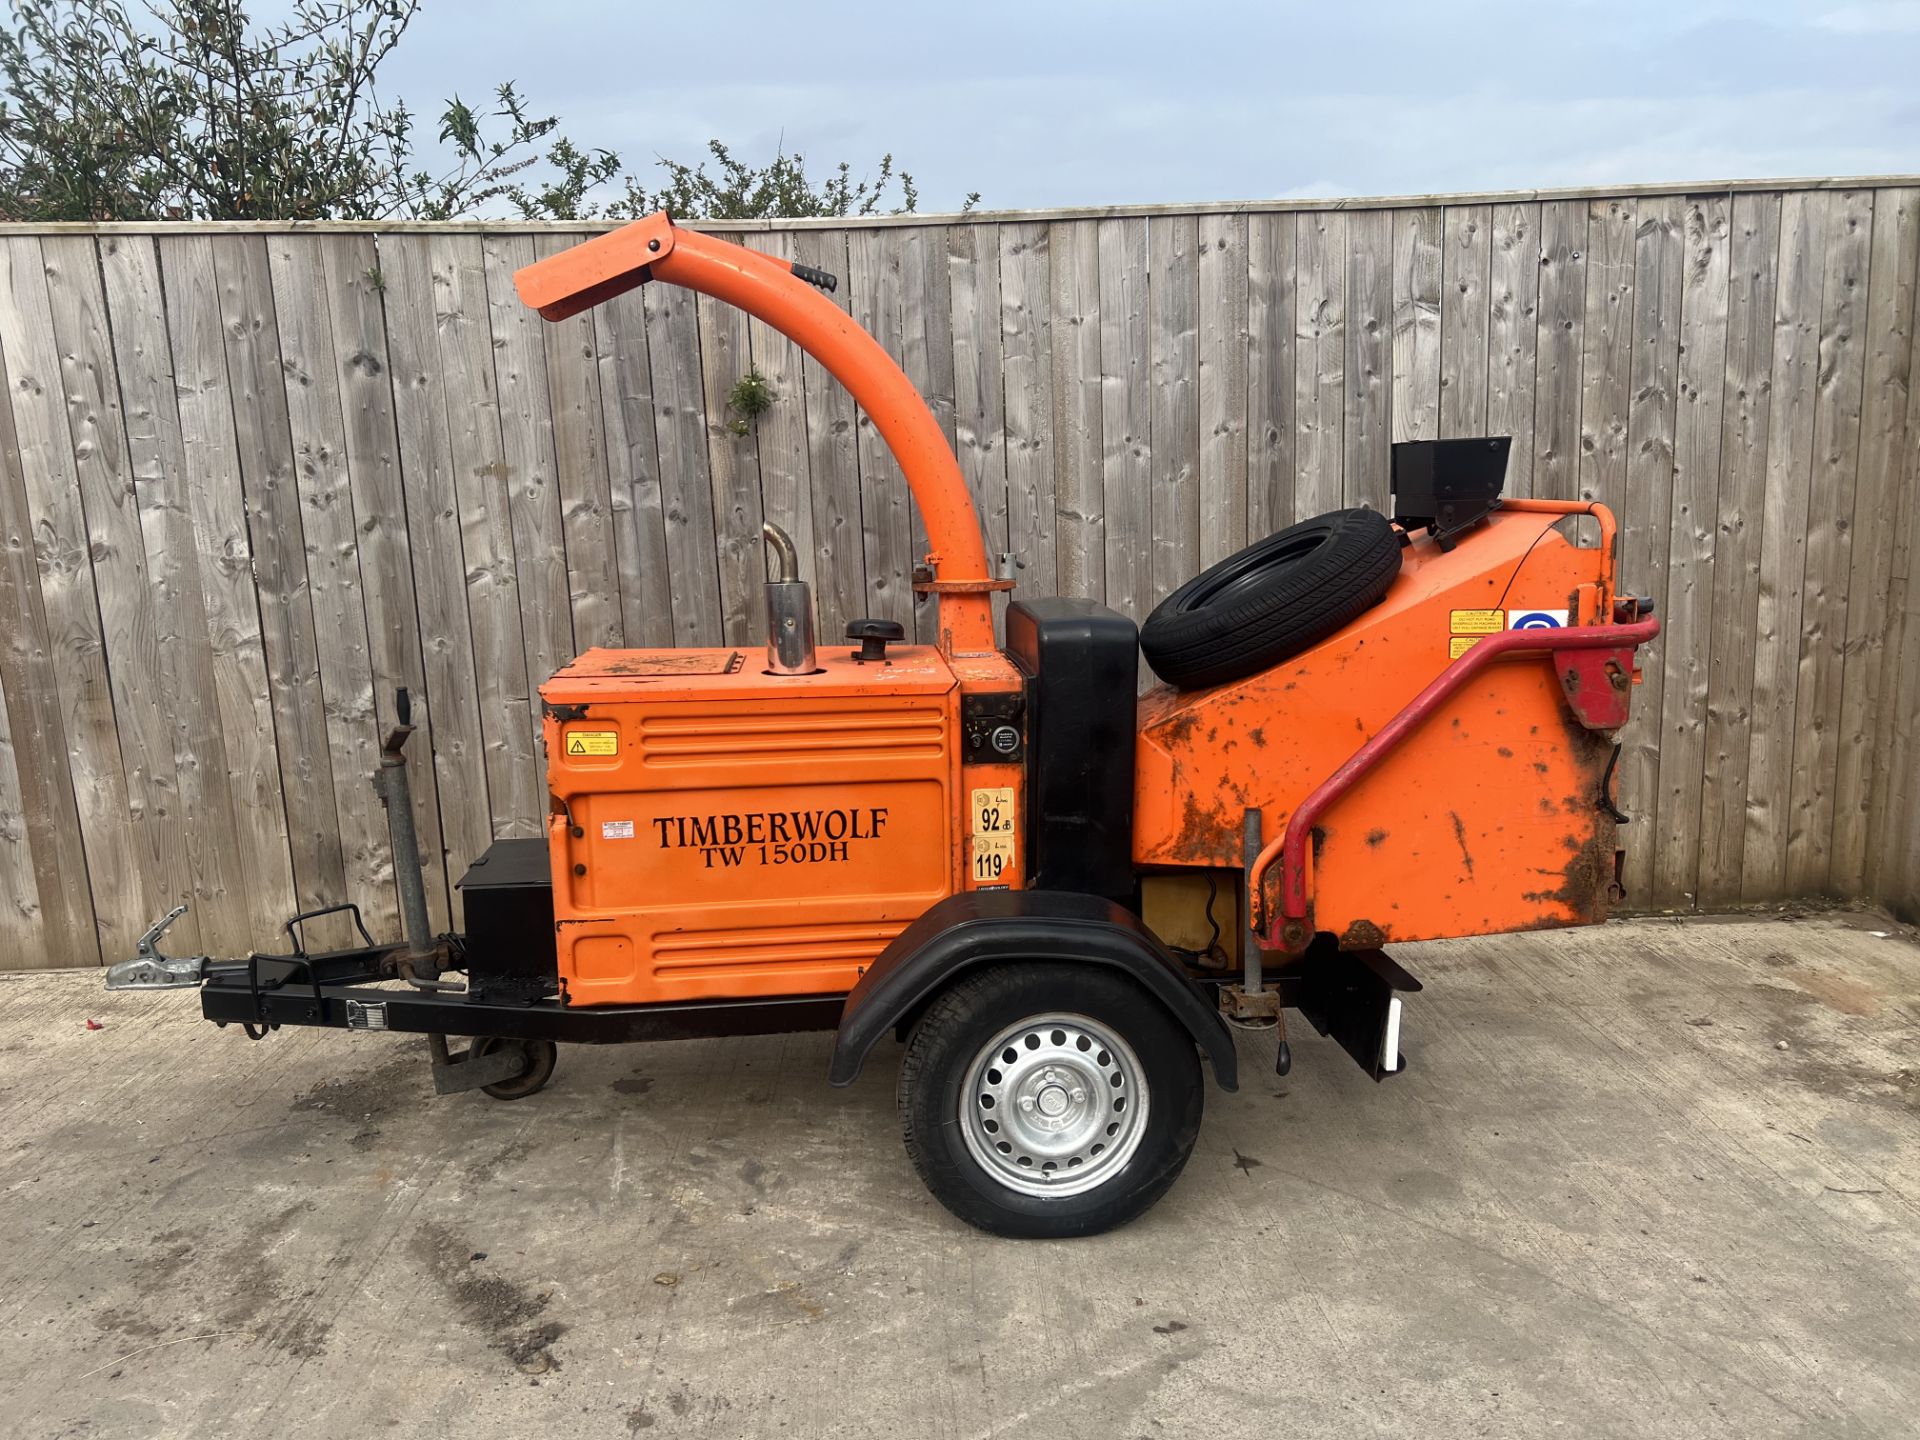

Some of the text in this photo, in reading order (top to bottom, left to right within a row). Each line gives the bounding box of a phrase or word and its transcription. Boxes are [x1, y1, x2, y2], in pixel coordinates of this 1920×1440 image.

[653, 808, 889, 848] TIMBERWOLF
[982, 807, 1000, 832] 92
[700, 841, 850, 868] TW 150DH
[976, 853, 1002, 877] 119
